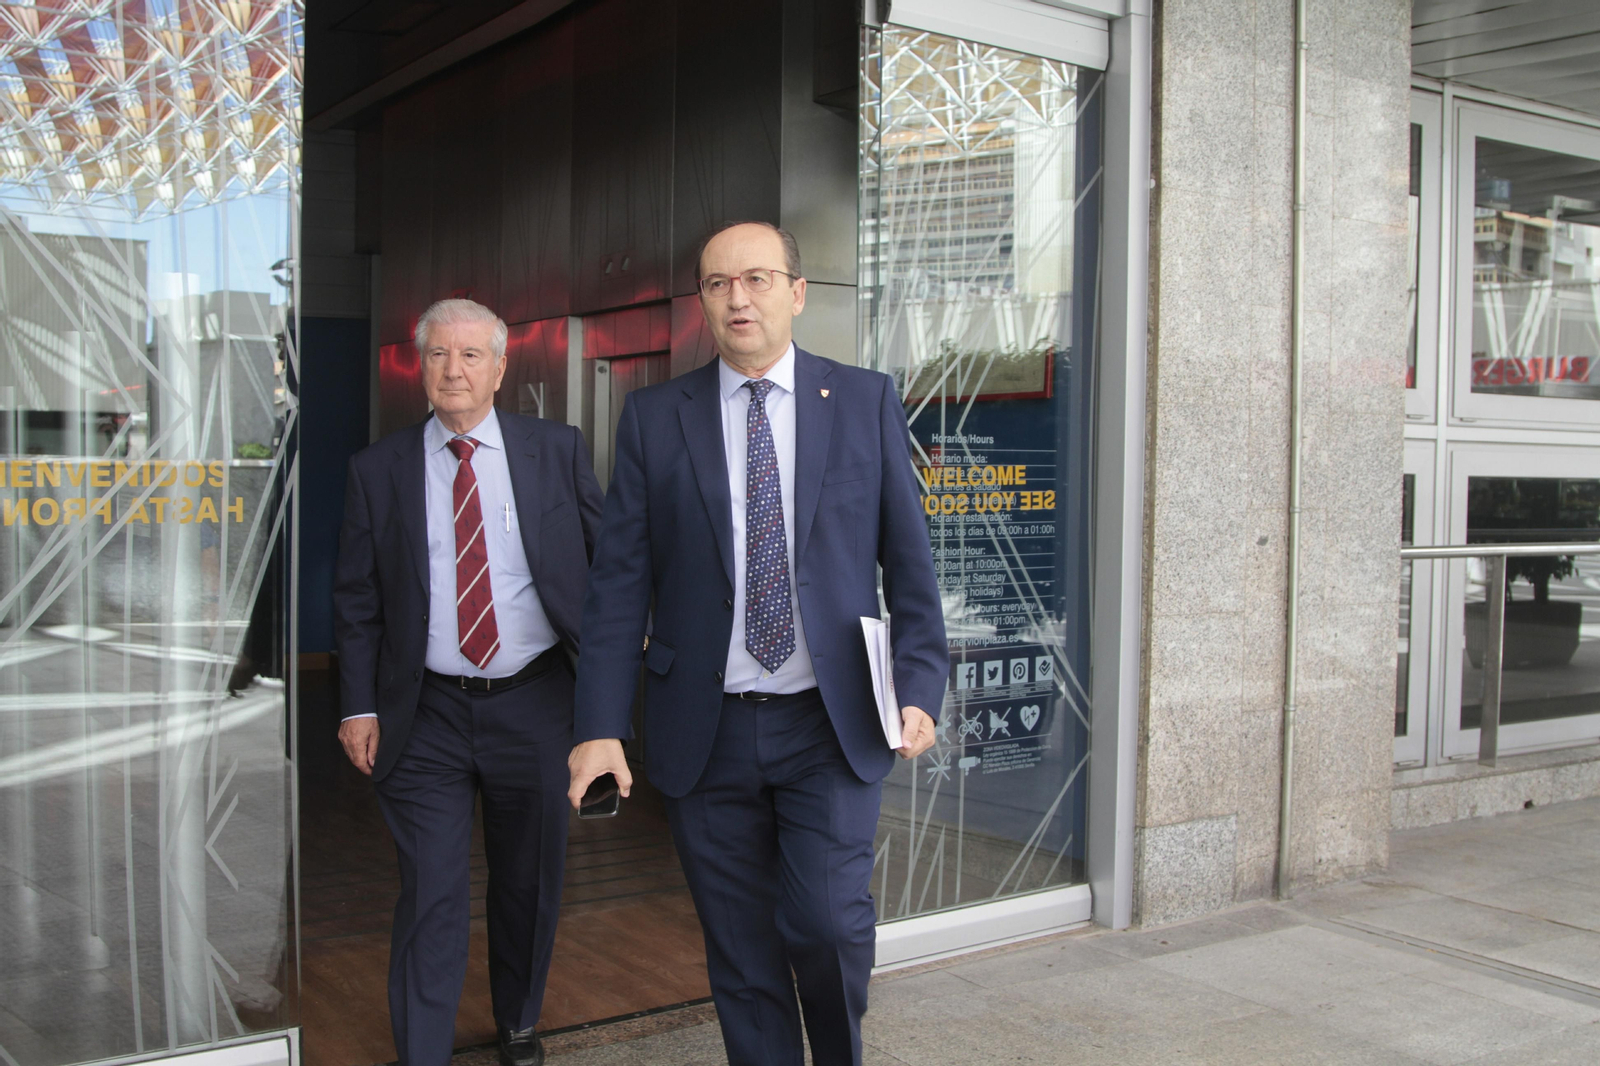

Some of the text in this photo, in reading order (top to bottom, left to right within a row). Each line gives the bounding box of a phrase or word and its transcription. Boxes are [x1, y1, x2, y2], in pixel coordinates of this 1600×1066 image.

[932, 433, 994, 444] Horarios/Hours
[932, 454, 988, 464] Horario moda:
[923, 465, 1026, 488] WELCOME
[930, 528, 953, 537] todos
[954, 527, 966, 536] los
[1030, 524, 1055, 534] 01:00h
[964, 546, 986, 556] Hour:
[966, 561, 974, 570] at
[976, 559, 1007, 571] 10:00pm
[937, 576, 962, 587] onday
[972, 572, 1006, 586] Saturday
[970, 586, 1004, 598] holidays)
[1002, 602, 1034, 613] everyday
[993, 616, 1026, 627] 01:00pm
